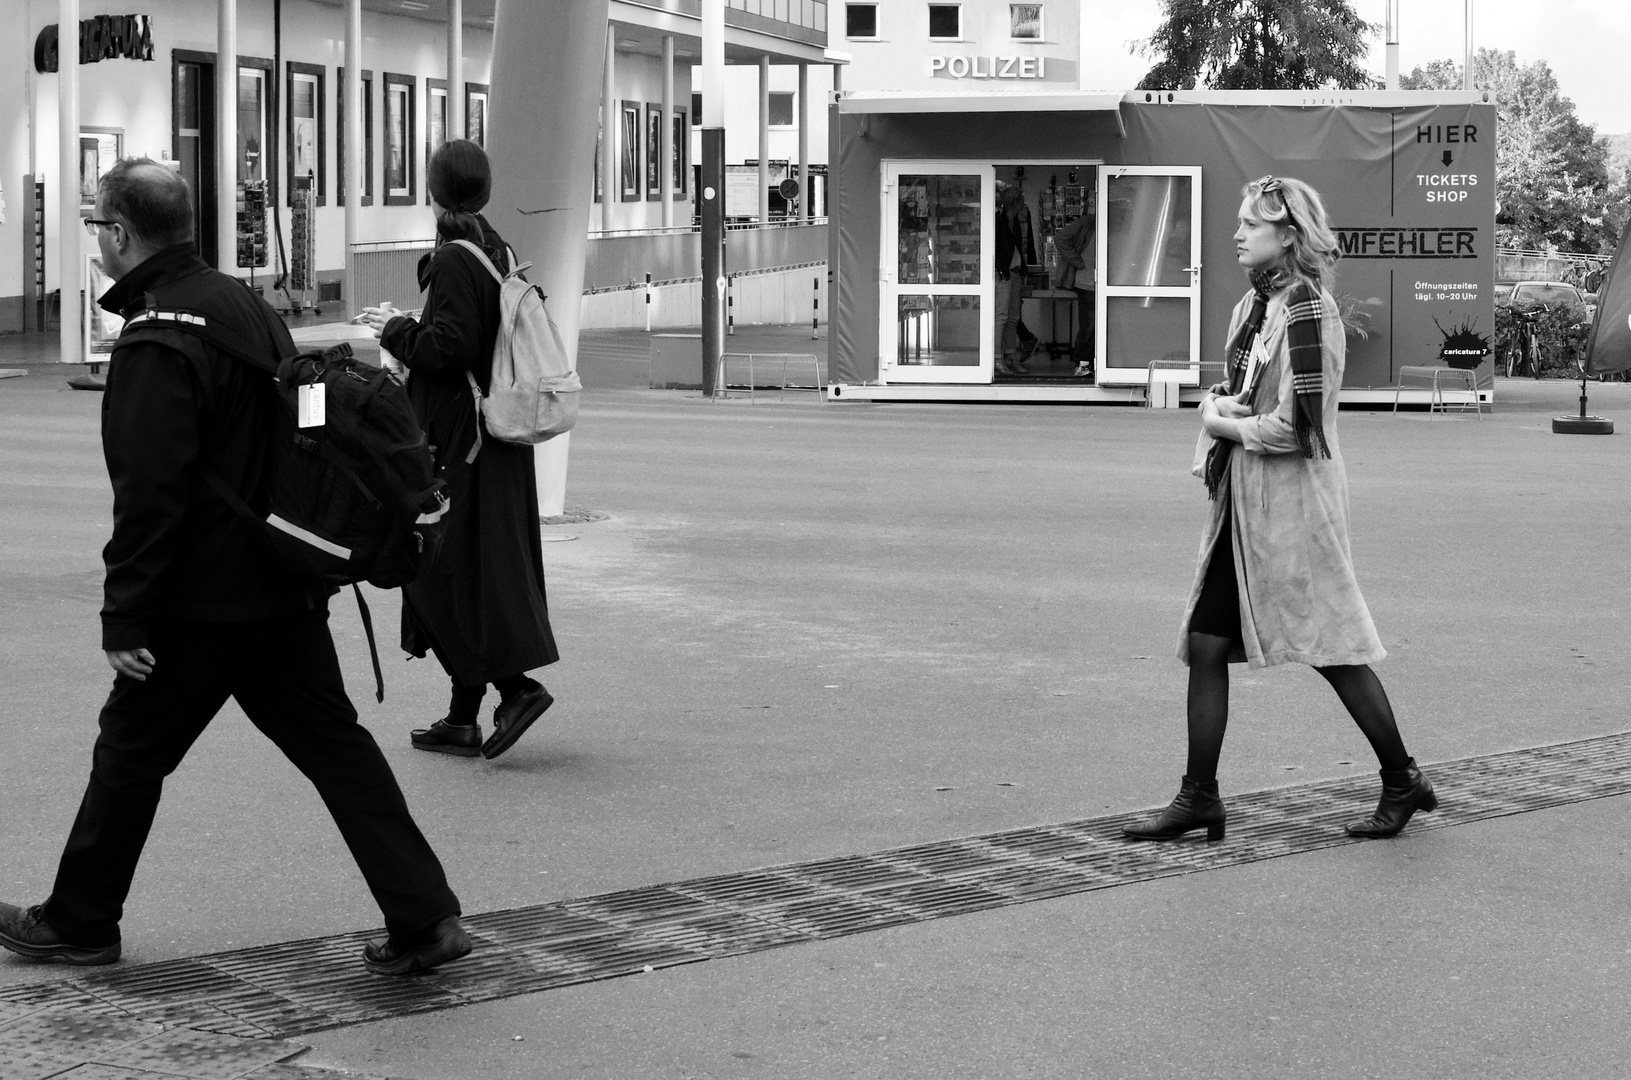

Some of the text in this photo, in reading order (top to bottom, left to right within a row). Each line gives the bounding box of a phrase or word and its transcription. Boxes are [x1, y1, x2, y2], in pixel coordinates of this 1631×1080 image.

[34, 14, 155, 74] CICATURA
[928, 55, 1045, 78] POLIZEI
[1417, 125, 1478, 143] HIER
[1416, 174, 1478, 186] TICKETS
[1426, 190, 1468, 202] SHOP
[1338, 231, 1475, 254] MFEHLER
[1414, 281, 1478, 291] Öffnungszeiten
[1414, 292, 1434, 302] tägl.
[1462, 292, 1478, 300] Uhr
[313, 389, 321, 420] cantus
